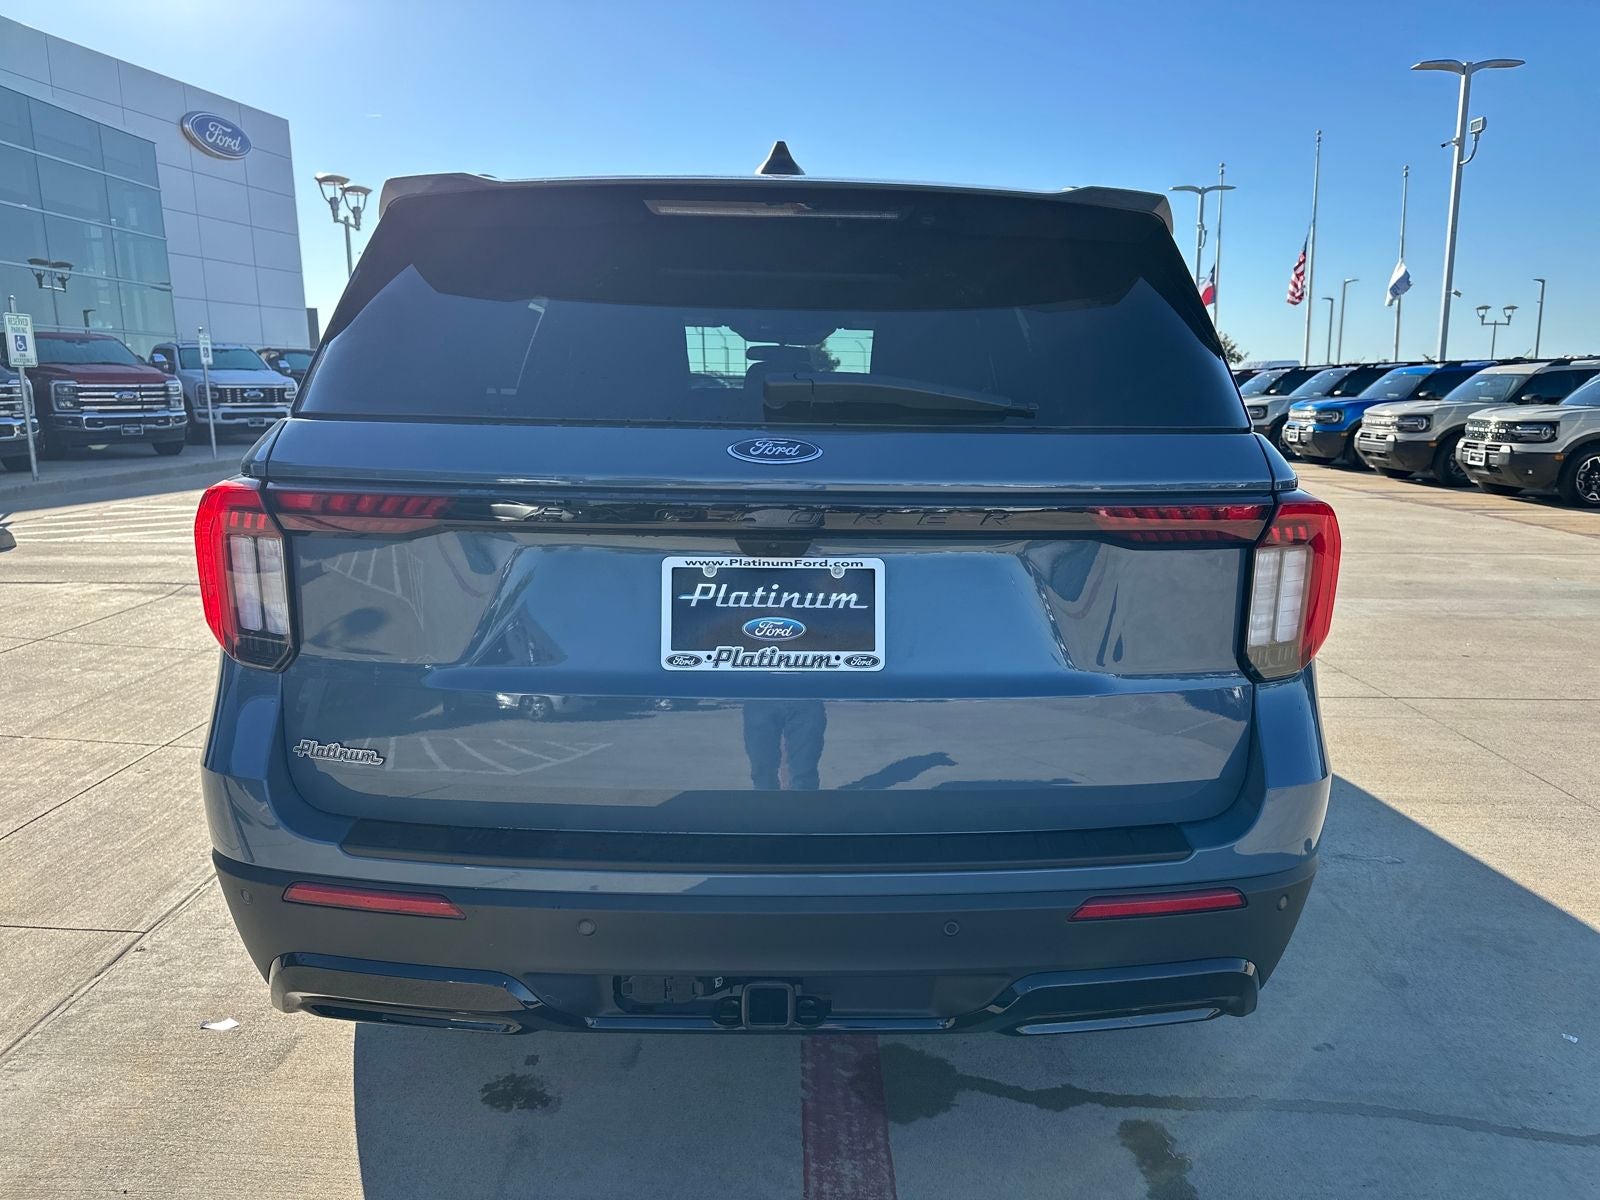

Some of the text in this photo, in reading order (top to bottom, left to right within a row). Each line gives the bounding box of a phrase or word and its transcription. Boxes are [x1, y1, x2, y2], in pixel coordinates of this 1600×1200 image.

[205, 121, 241, 151] Ford
[8, 317, 29, 326] RESERVED
[749, 439, 801, 456] Ford
[685, 558, 864, 568] www.PlatinumFord.com
[678, 583, 869, 609] Platinum
[754, 619, 793, 637] Ford
[672, 646, 874, 669] Ford Platinum Ford
[293, 739, 384, 765] Platinum
